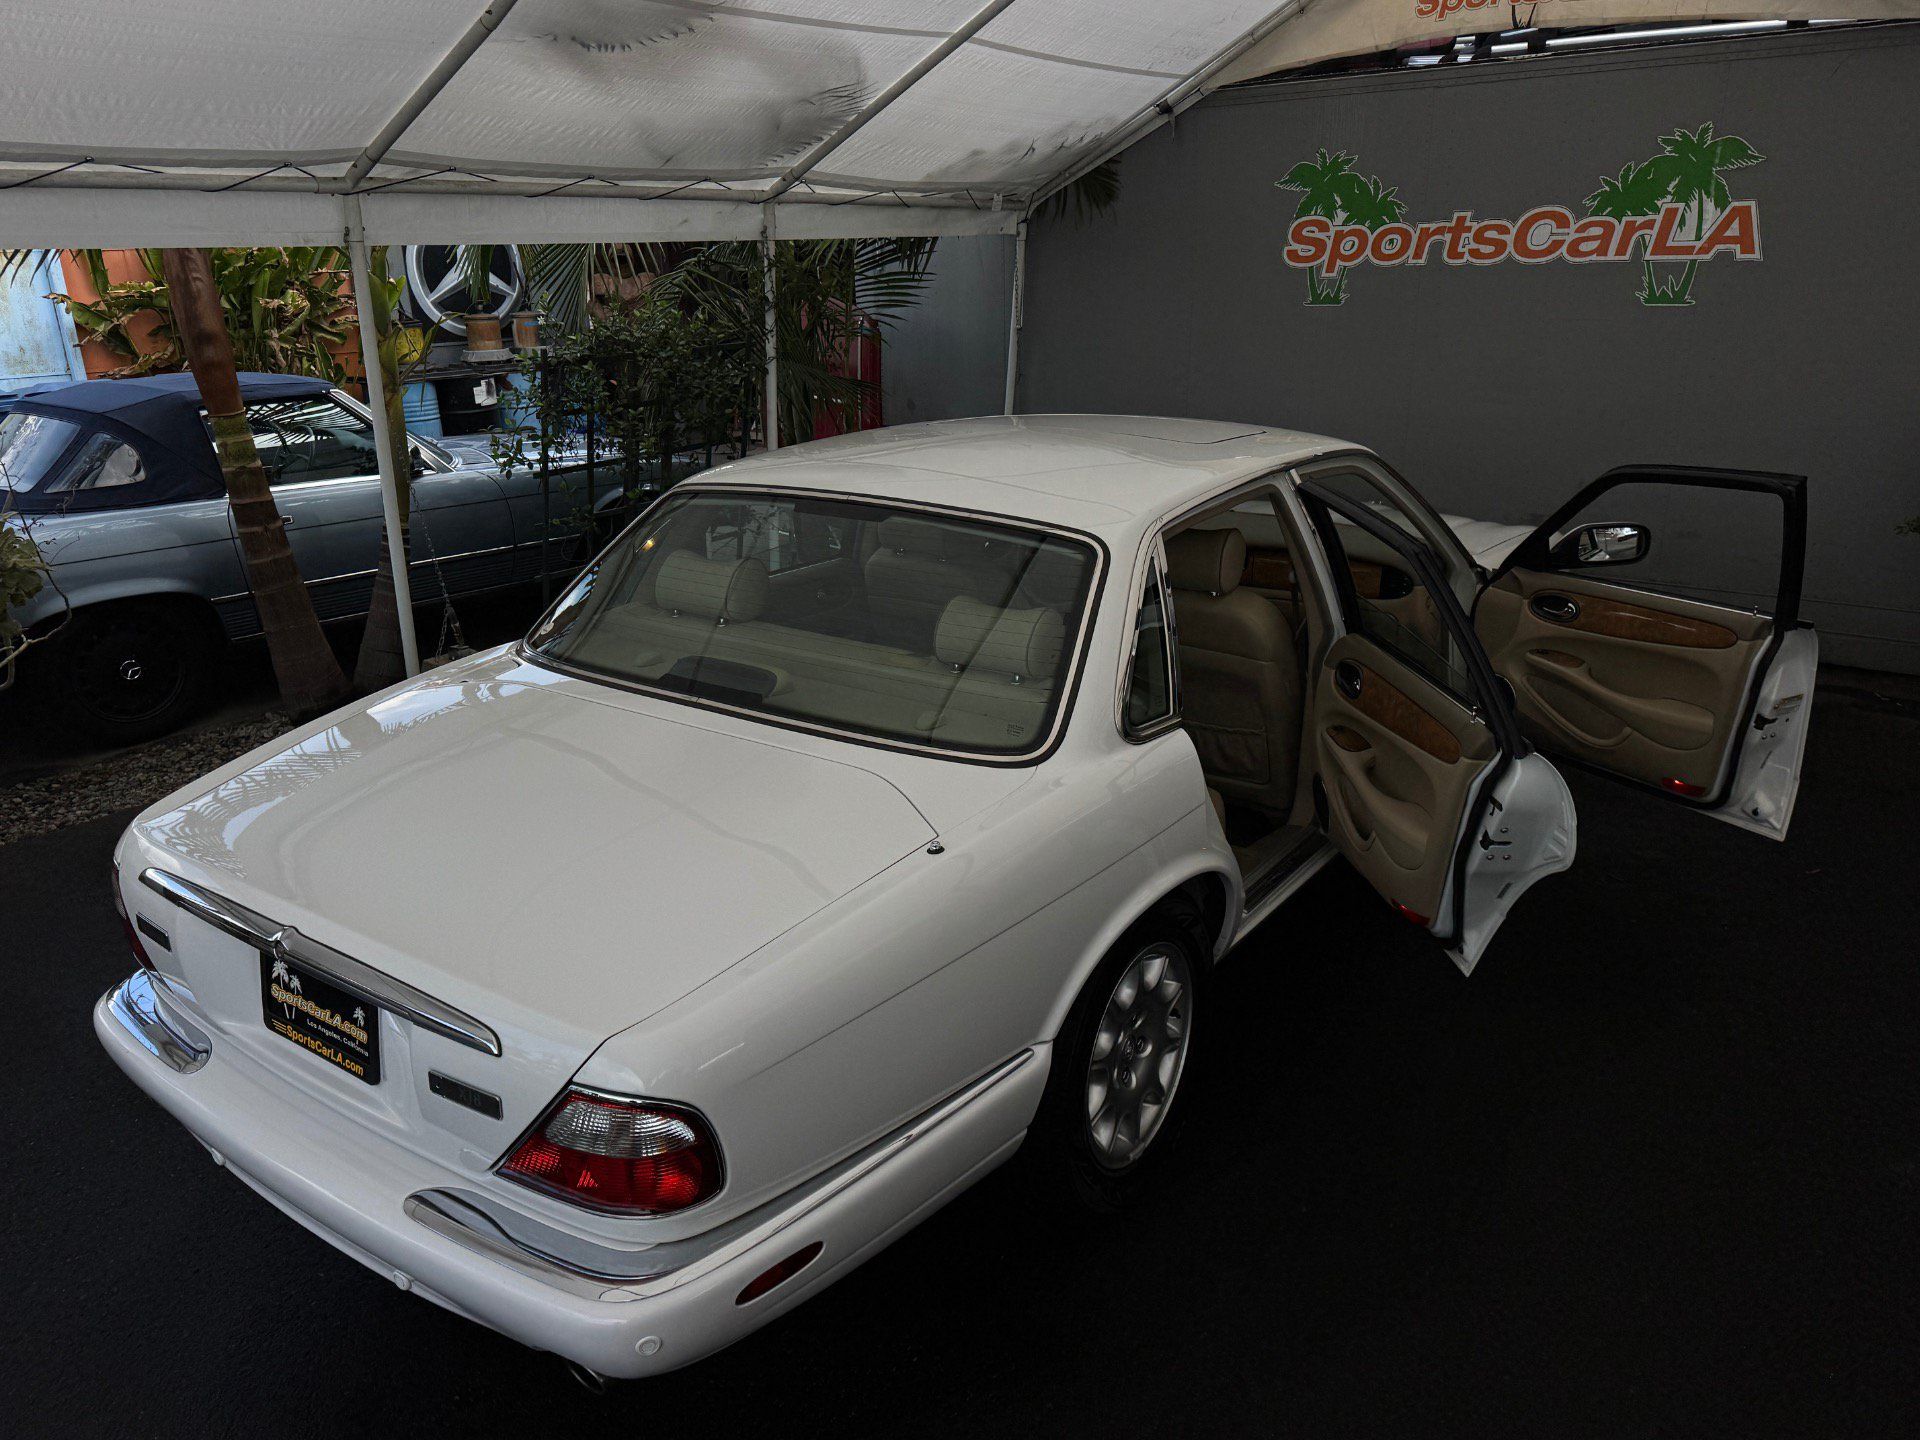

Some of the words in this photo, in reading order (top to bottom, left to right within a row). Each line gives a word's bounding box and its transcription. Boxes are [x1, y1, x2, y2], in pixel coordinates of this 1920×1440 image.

[1286, 200, 1761, 277] SportsCarLA
[271, 984, 368, 1044] SportsCarLA.com
[286, 1025, 364, 1076] SportsCarLA.com
